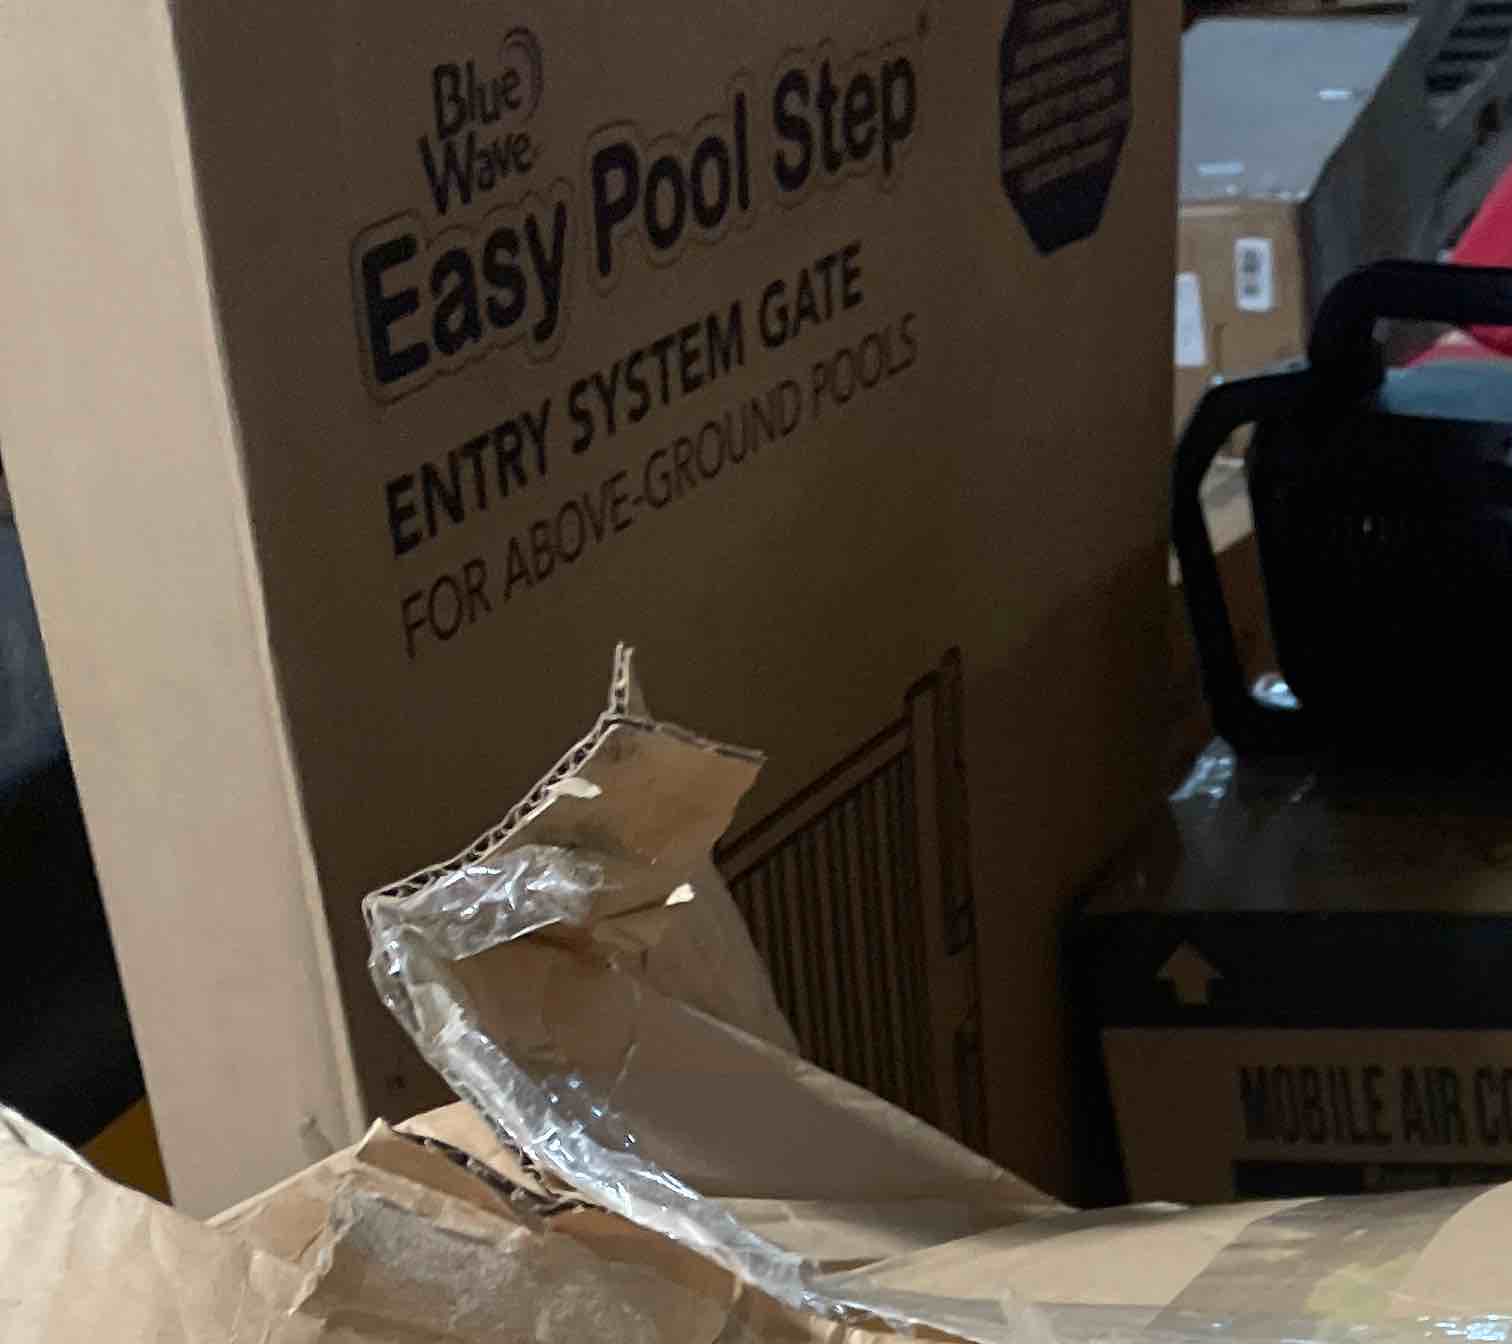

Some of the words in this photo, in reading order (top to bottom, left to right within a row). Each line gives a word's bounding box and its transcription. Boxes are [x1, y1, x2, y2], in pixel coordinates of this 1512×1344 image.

[418, 134, 533, 215] Wave
[433, 62, 524, 141] Blue
[362, 202, 567, 384] Easy
[592, 91, 750, 277] Pool
[772, 56, 917, 192] Step
[384, 401, 552, 559] ENTRY
[569, 301, 744, 456] SYSTEM
[757, 240, 865, 351] GATE
[402, 557, 491, 660] FOR
[504, 380, 798, 601] ABOVE-GROUND
[812, 313, 919, 422] POOLS
[1239, 1065, 1393, 1146] MOBILE
[1401, 1066, 1468, 1148] AIR
